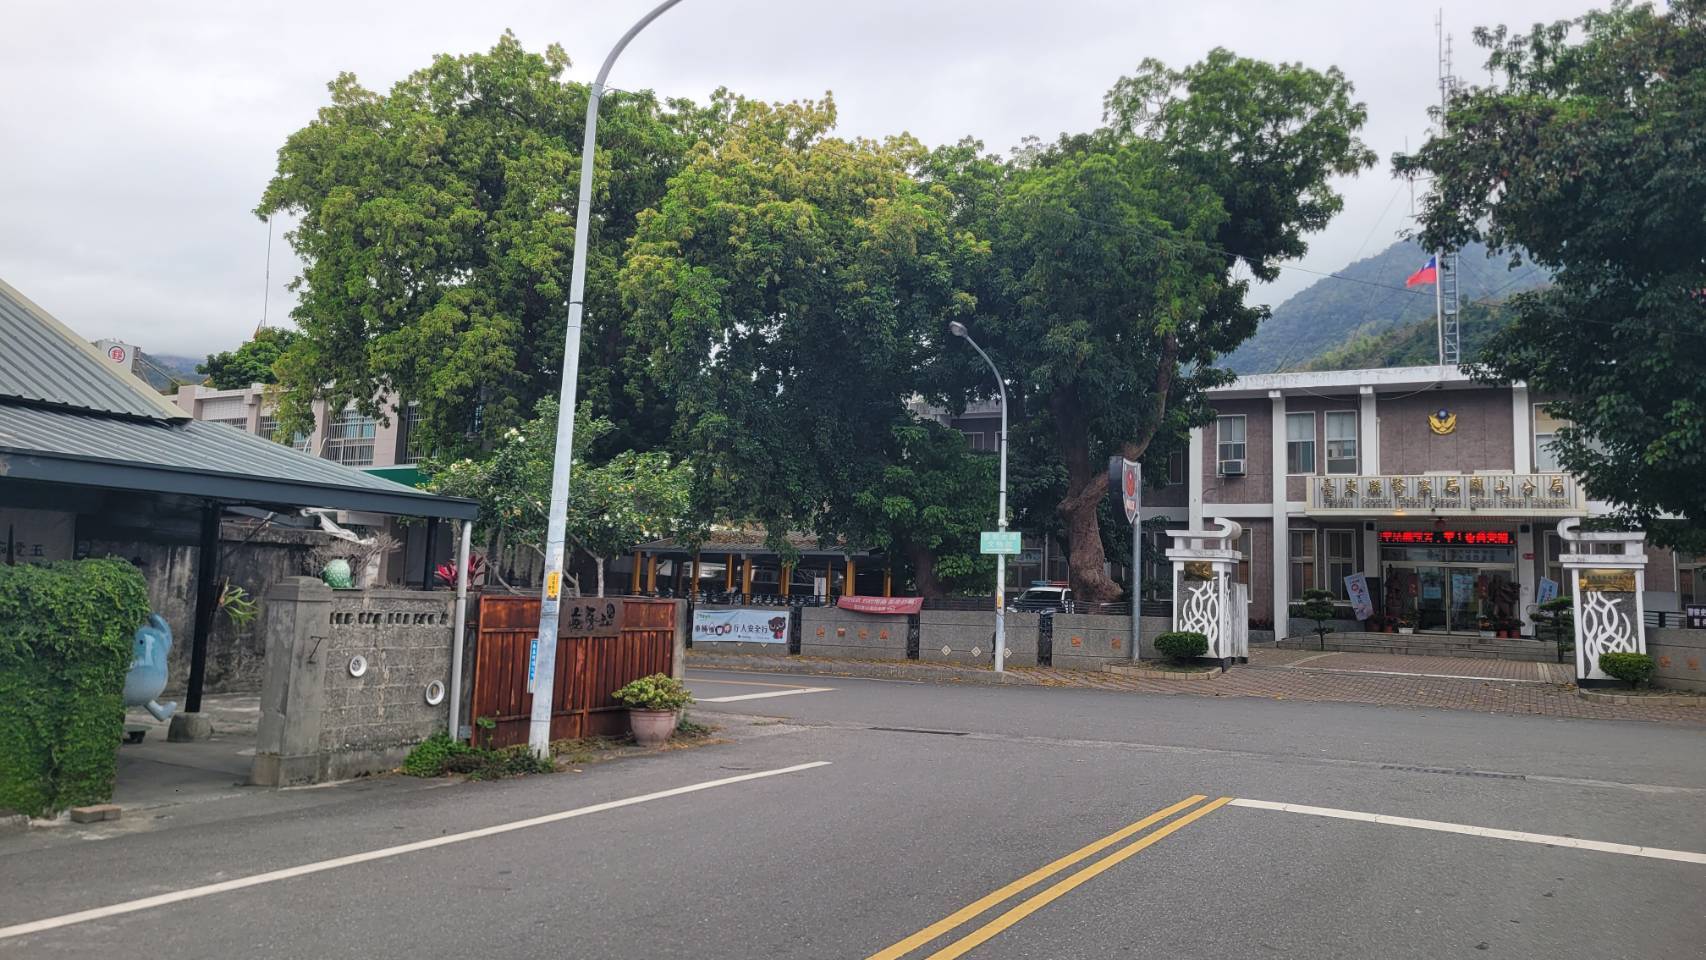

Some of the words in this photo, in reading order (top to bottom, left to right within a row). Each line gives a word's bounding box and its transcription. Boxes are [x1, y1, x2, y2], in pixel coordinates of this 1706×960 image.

[1321, 477, 1565, 497] 臺東縣警察局關山分局
